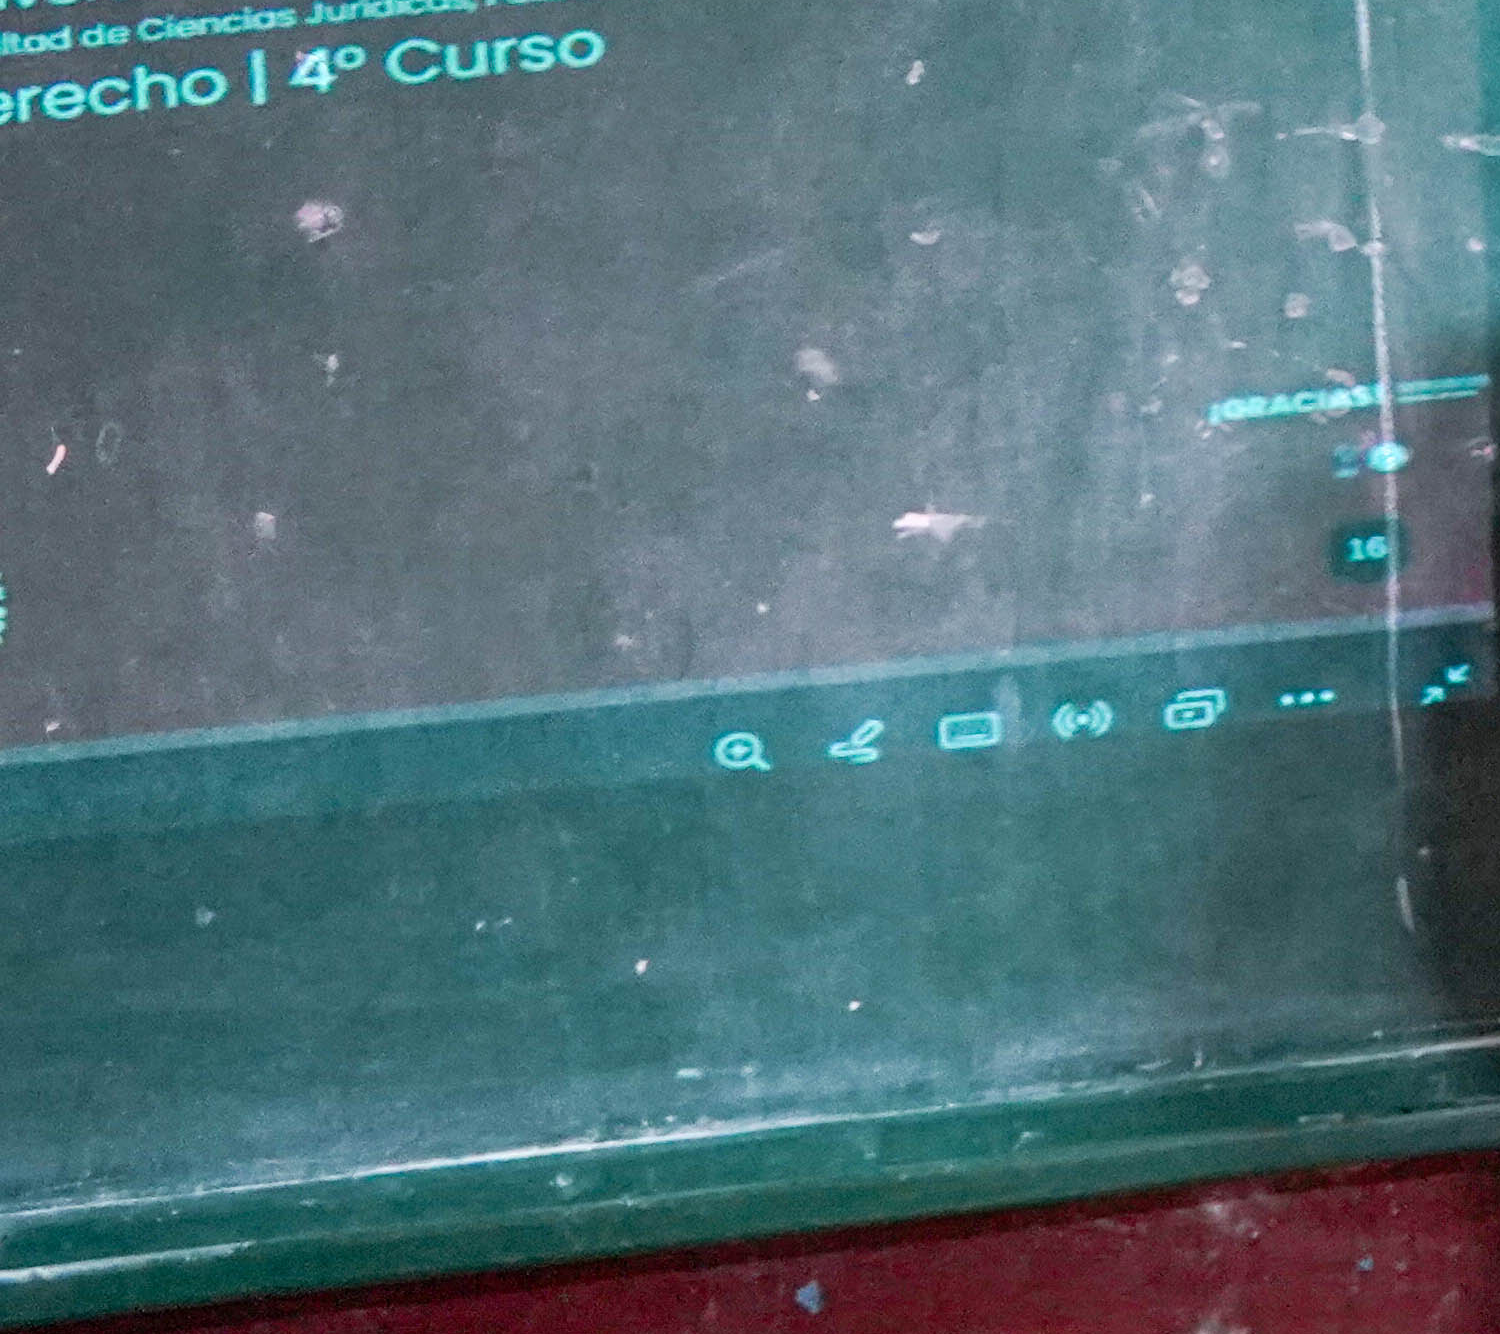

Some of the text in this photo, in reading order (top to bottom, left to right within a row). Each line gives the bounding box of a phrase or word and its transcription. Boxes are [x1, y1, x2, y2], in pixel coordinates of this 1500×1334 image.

[78, 23, 133, 49] de
[135, 6, 298, 42] Ciencias
[383, 27, 608, 87] Curso
